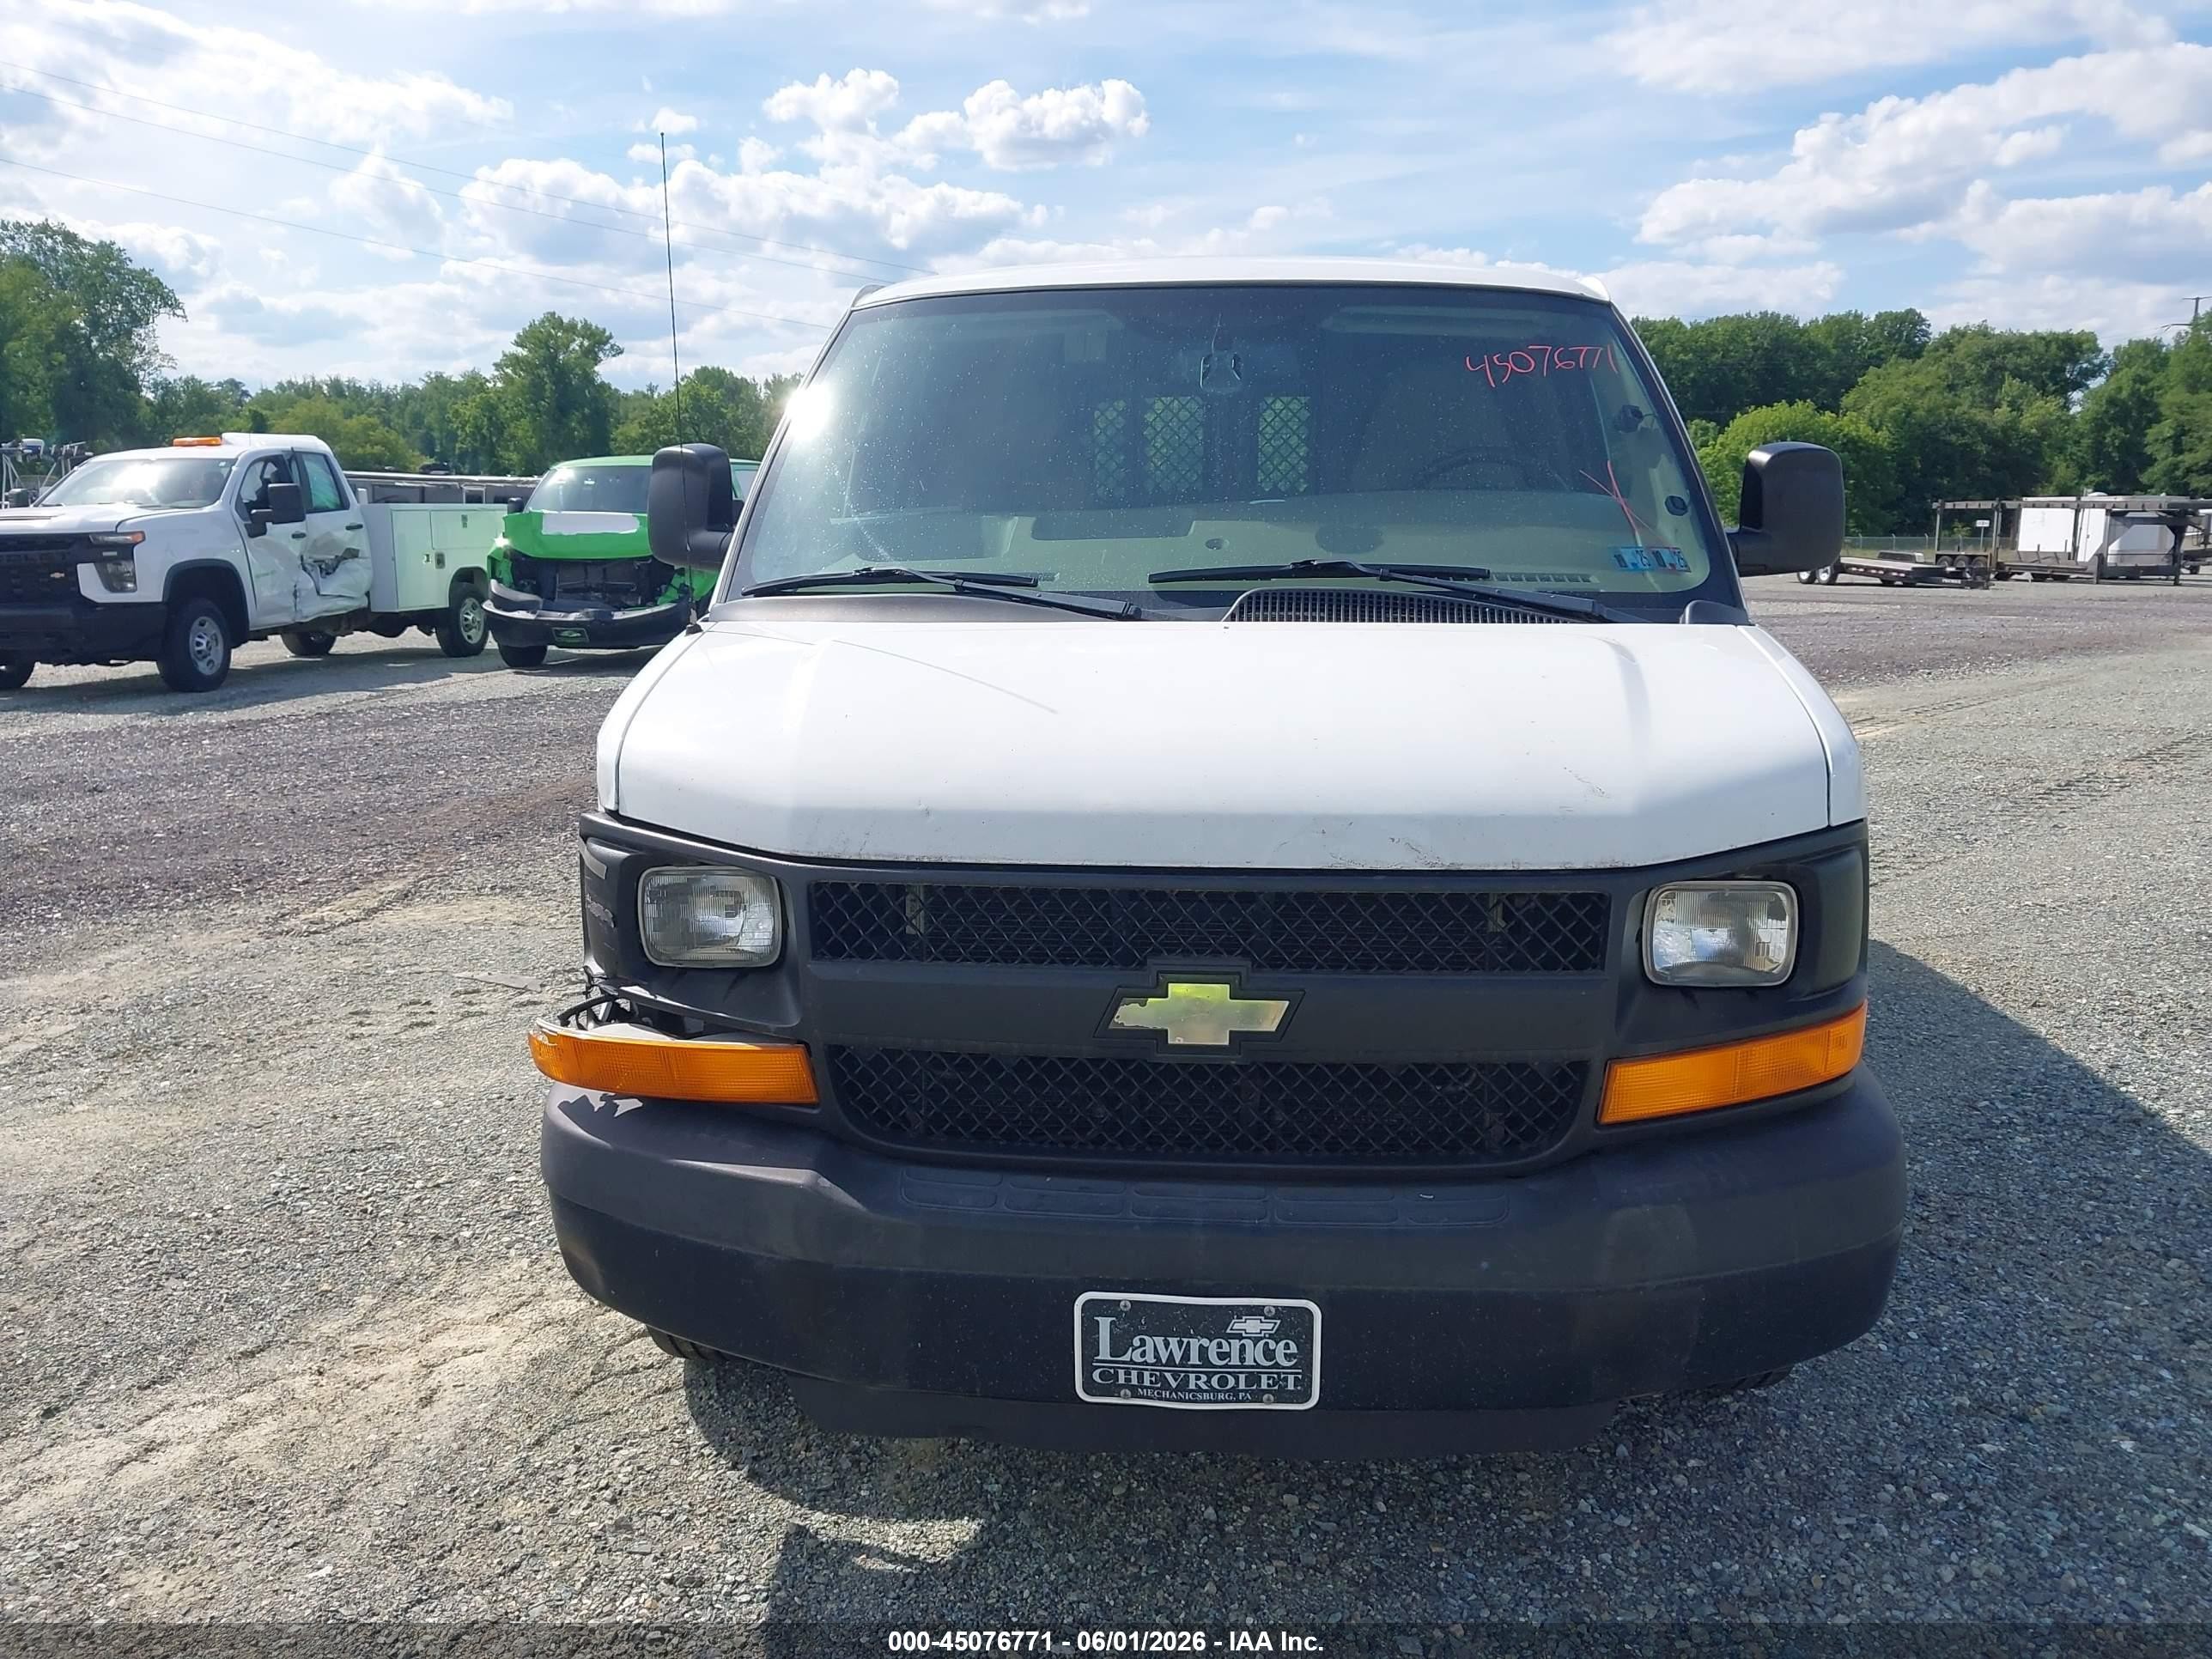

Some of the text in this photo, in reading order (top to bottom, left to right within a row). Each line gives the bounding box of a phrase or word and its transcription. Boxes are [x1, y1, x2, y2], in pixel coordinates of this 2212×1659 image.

[1465, 344, 1619, 387] 45076771
[1093, 1316, 1298, 1367] Lawrence
[1137, 1388, 1252, 1401] MECHANICSBURG, PA
